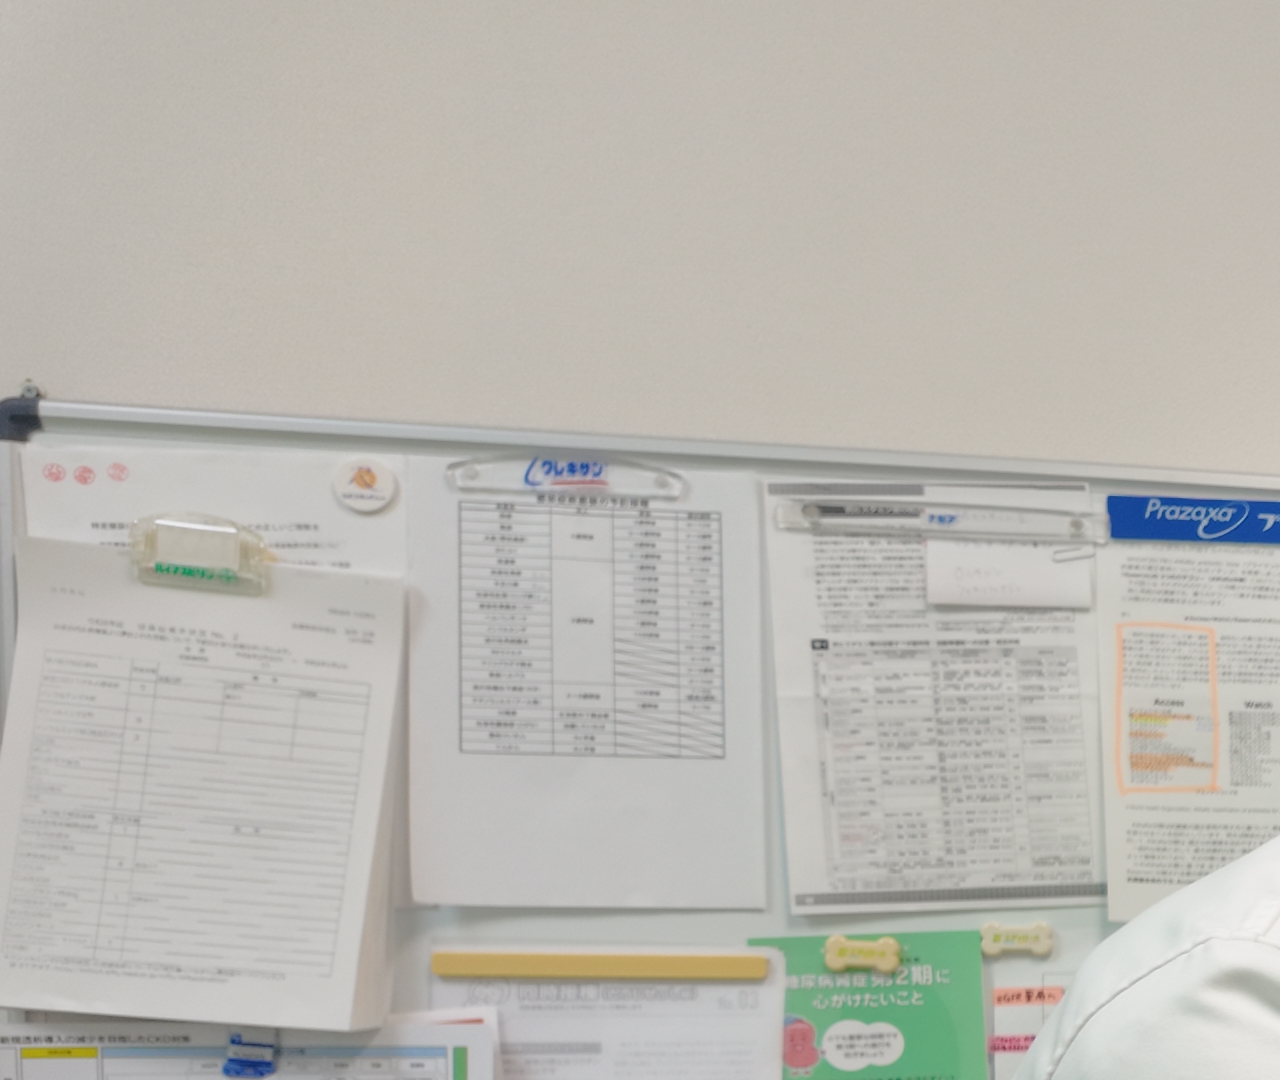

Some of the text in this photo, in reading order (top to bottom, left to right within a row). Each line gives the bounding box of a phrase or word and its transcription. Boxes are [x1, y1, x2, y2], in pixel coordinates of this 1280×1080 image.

[1145, 498, 1240, 530] Prazaxa
[1154, 698, 1185, 707] Access
[812, 990, 925, 1010] 心がけたいこと
